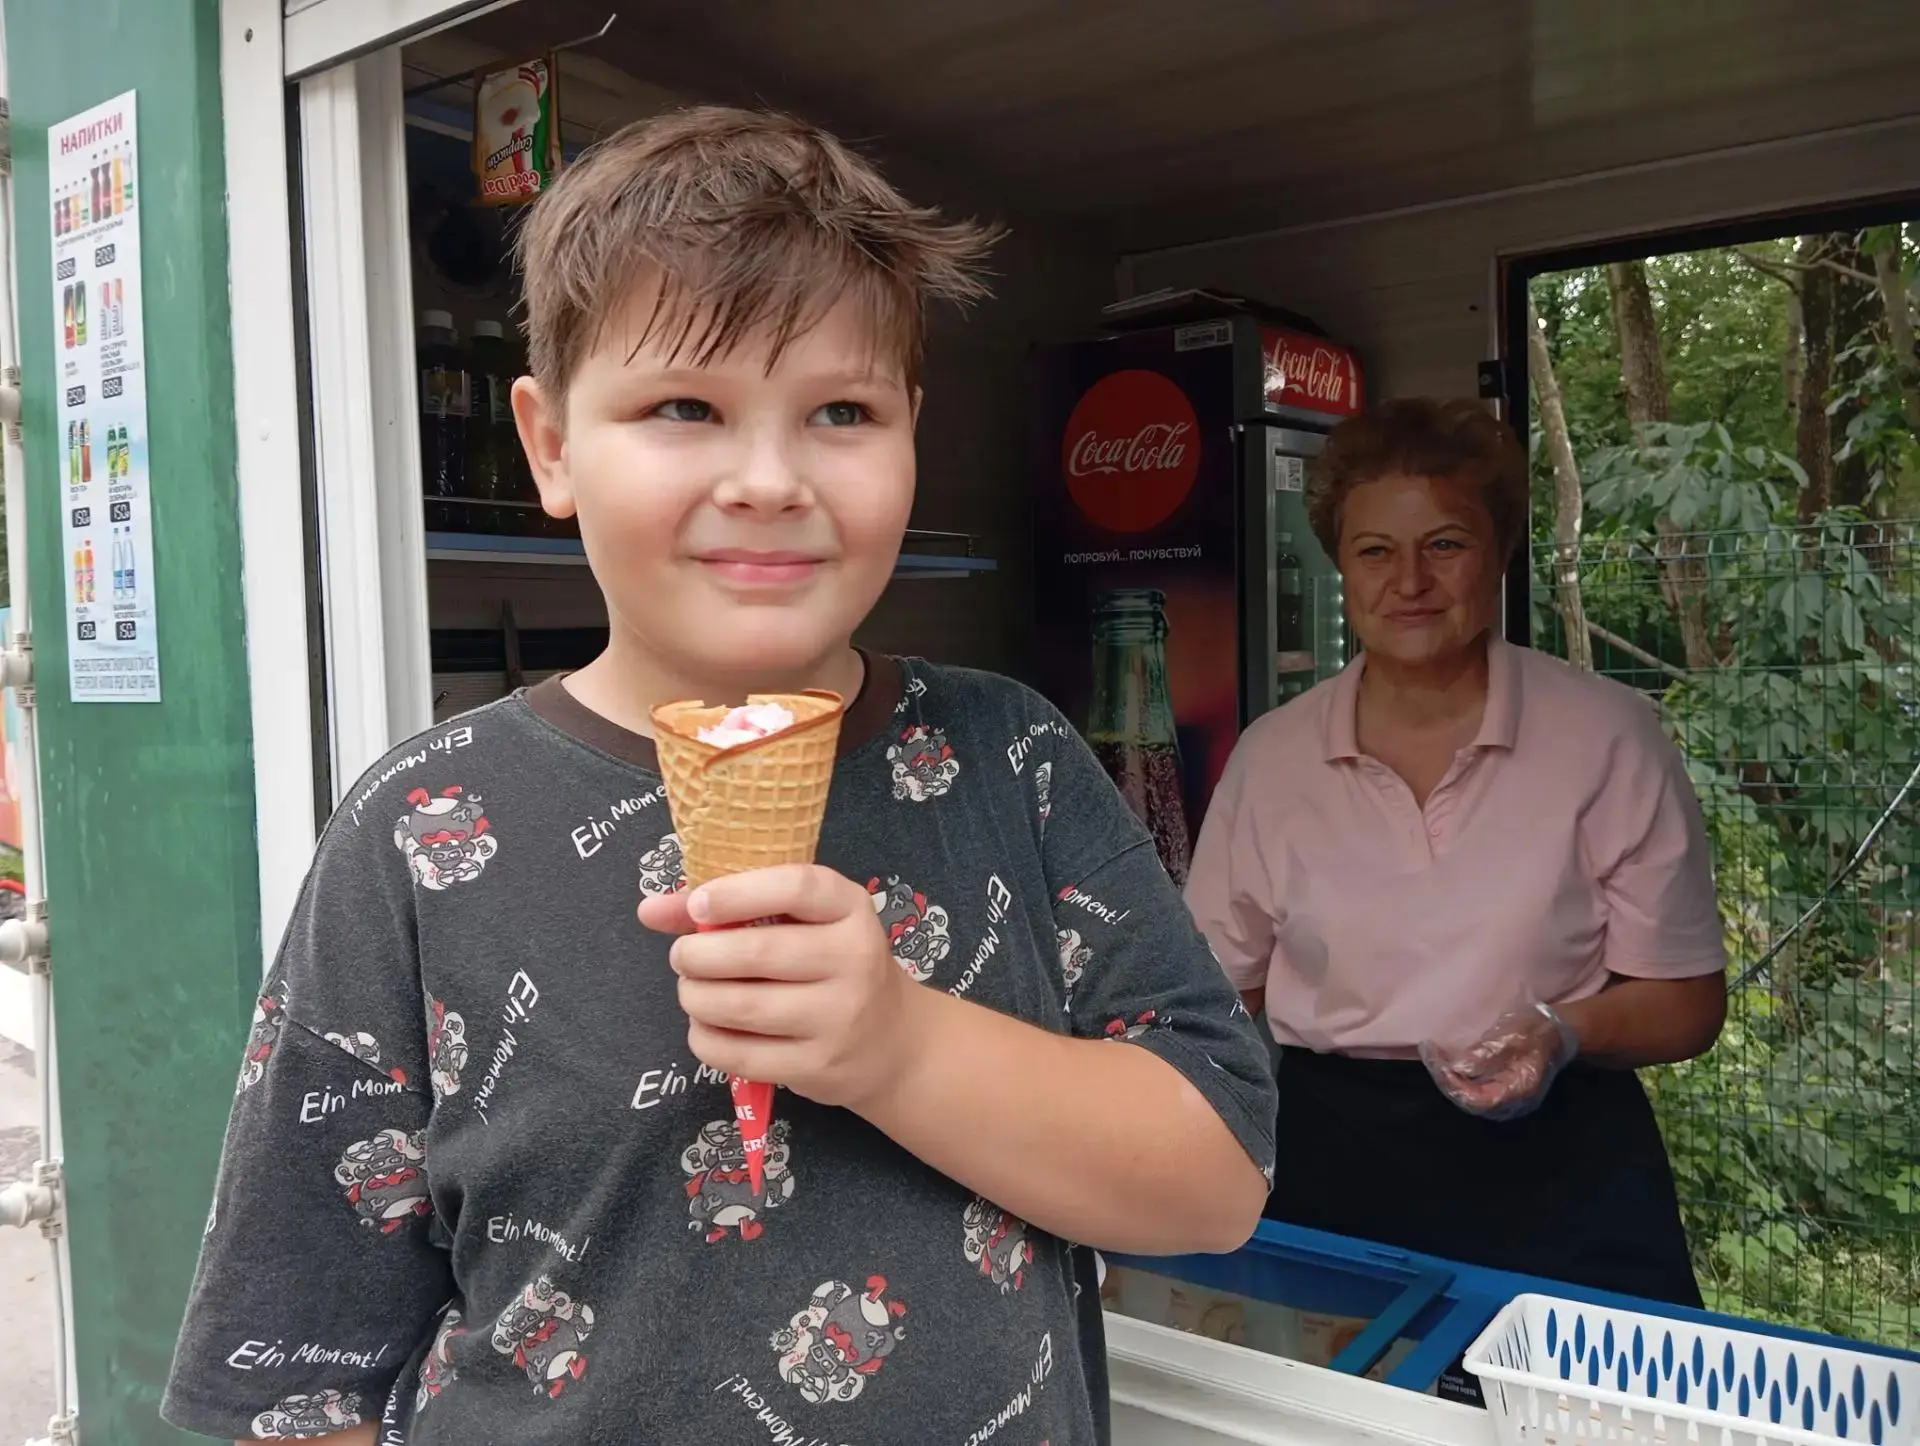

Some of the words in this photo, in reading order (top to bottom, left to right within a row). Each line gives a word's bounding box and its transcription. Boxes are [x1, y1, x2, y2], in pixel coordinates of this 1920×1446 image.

[61, 112, 123, 155] НАПИТКИ
[507, 172, 541, 193] Good
[1266, 338, 1341, 402] Coca-Cola
[1069, 422, 1193, 477] Coca-Cola
[1129, 544, 1202, 560] ПОЧУВСТВУЙ
[430, 726, 473, 754] Ein
[1007, 736, 1033, 776] Ein
[351, 750, 427, 827] Moment!
[570, 816, 616, 860] Ein
[986, 872, 1012, 925] Ein
[503, 967, 540, 1024] Ein
[473, 1027, 518, 1126] Moment!
[631, 1062, 687, 1110] Ein
[299, 1085, 346, 1124] Ein
[487, 1212, 520, 1243] Ein
[225, 1339, 286, 1370] Ein
[291, 1343, 388, 1369] Moment!
[1031, 1329, 1053, 1390] Ein
